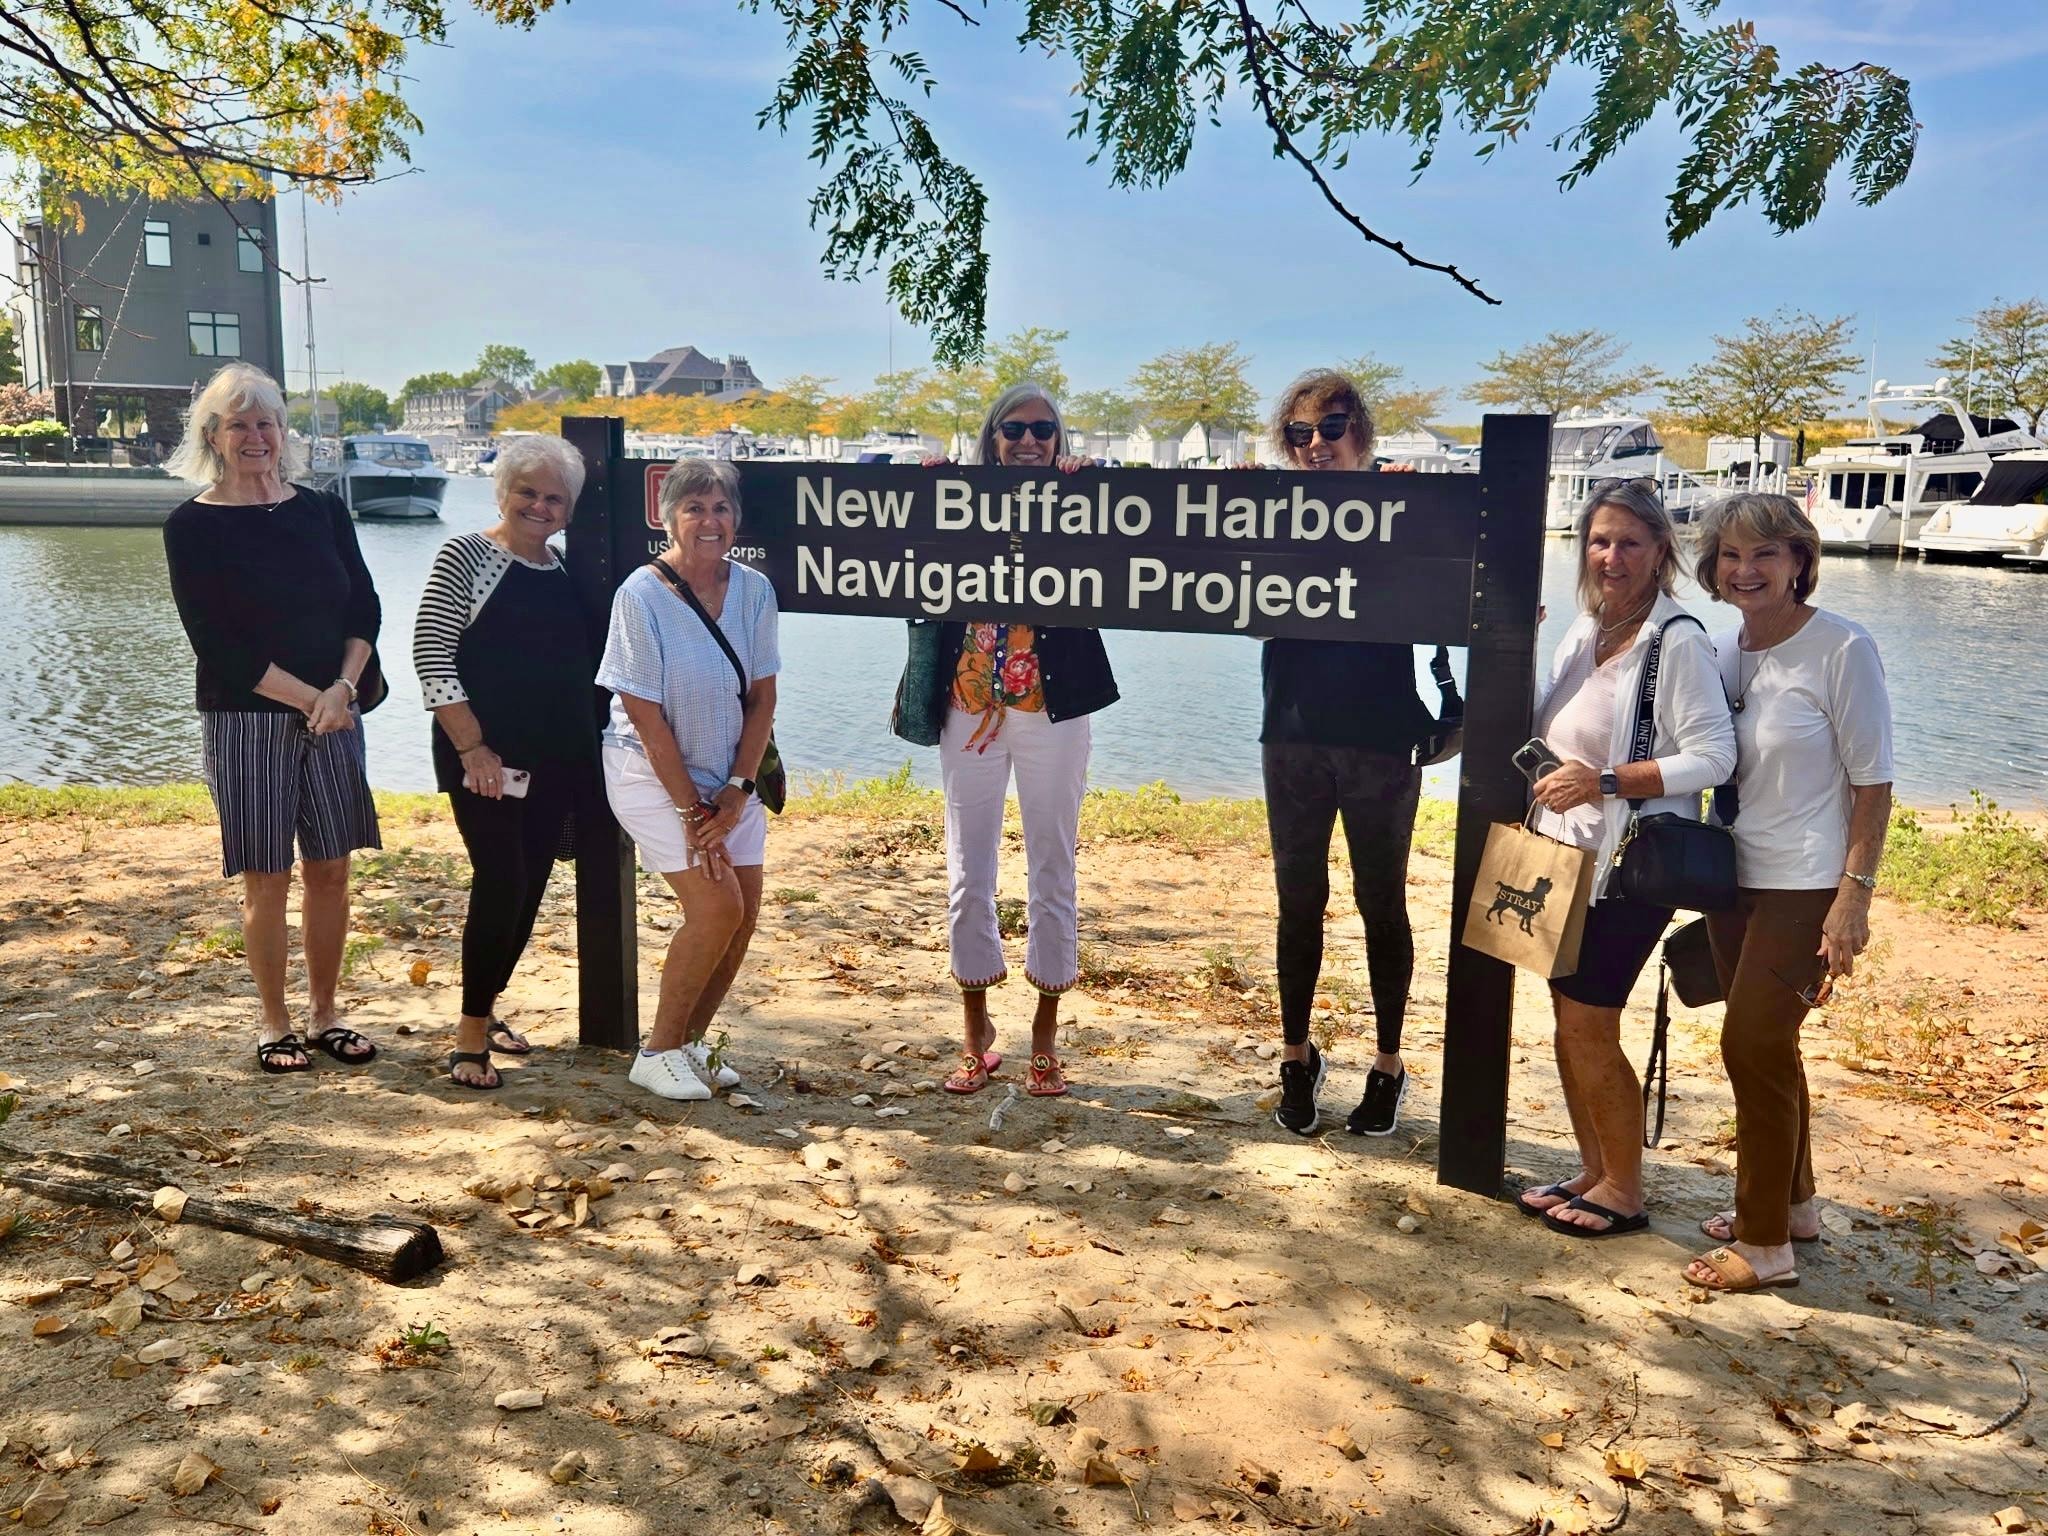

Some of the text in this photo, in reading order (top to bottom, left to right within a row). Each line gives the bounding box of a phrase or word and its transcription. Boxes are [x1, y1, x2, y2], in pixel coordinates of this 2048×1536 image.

[797, 477, 1406, 541] New Buffalo Harbor
[723, 546, 766, 562] orps
[797, 546, 1358, 628] Navigation Project
[1642, 648, 1659, 702] VINEYARD
[1498, 890, 1540, 911] STRAY
